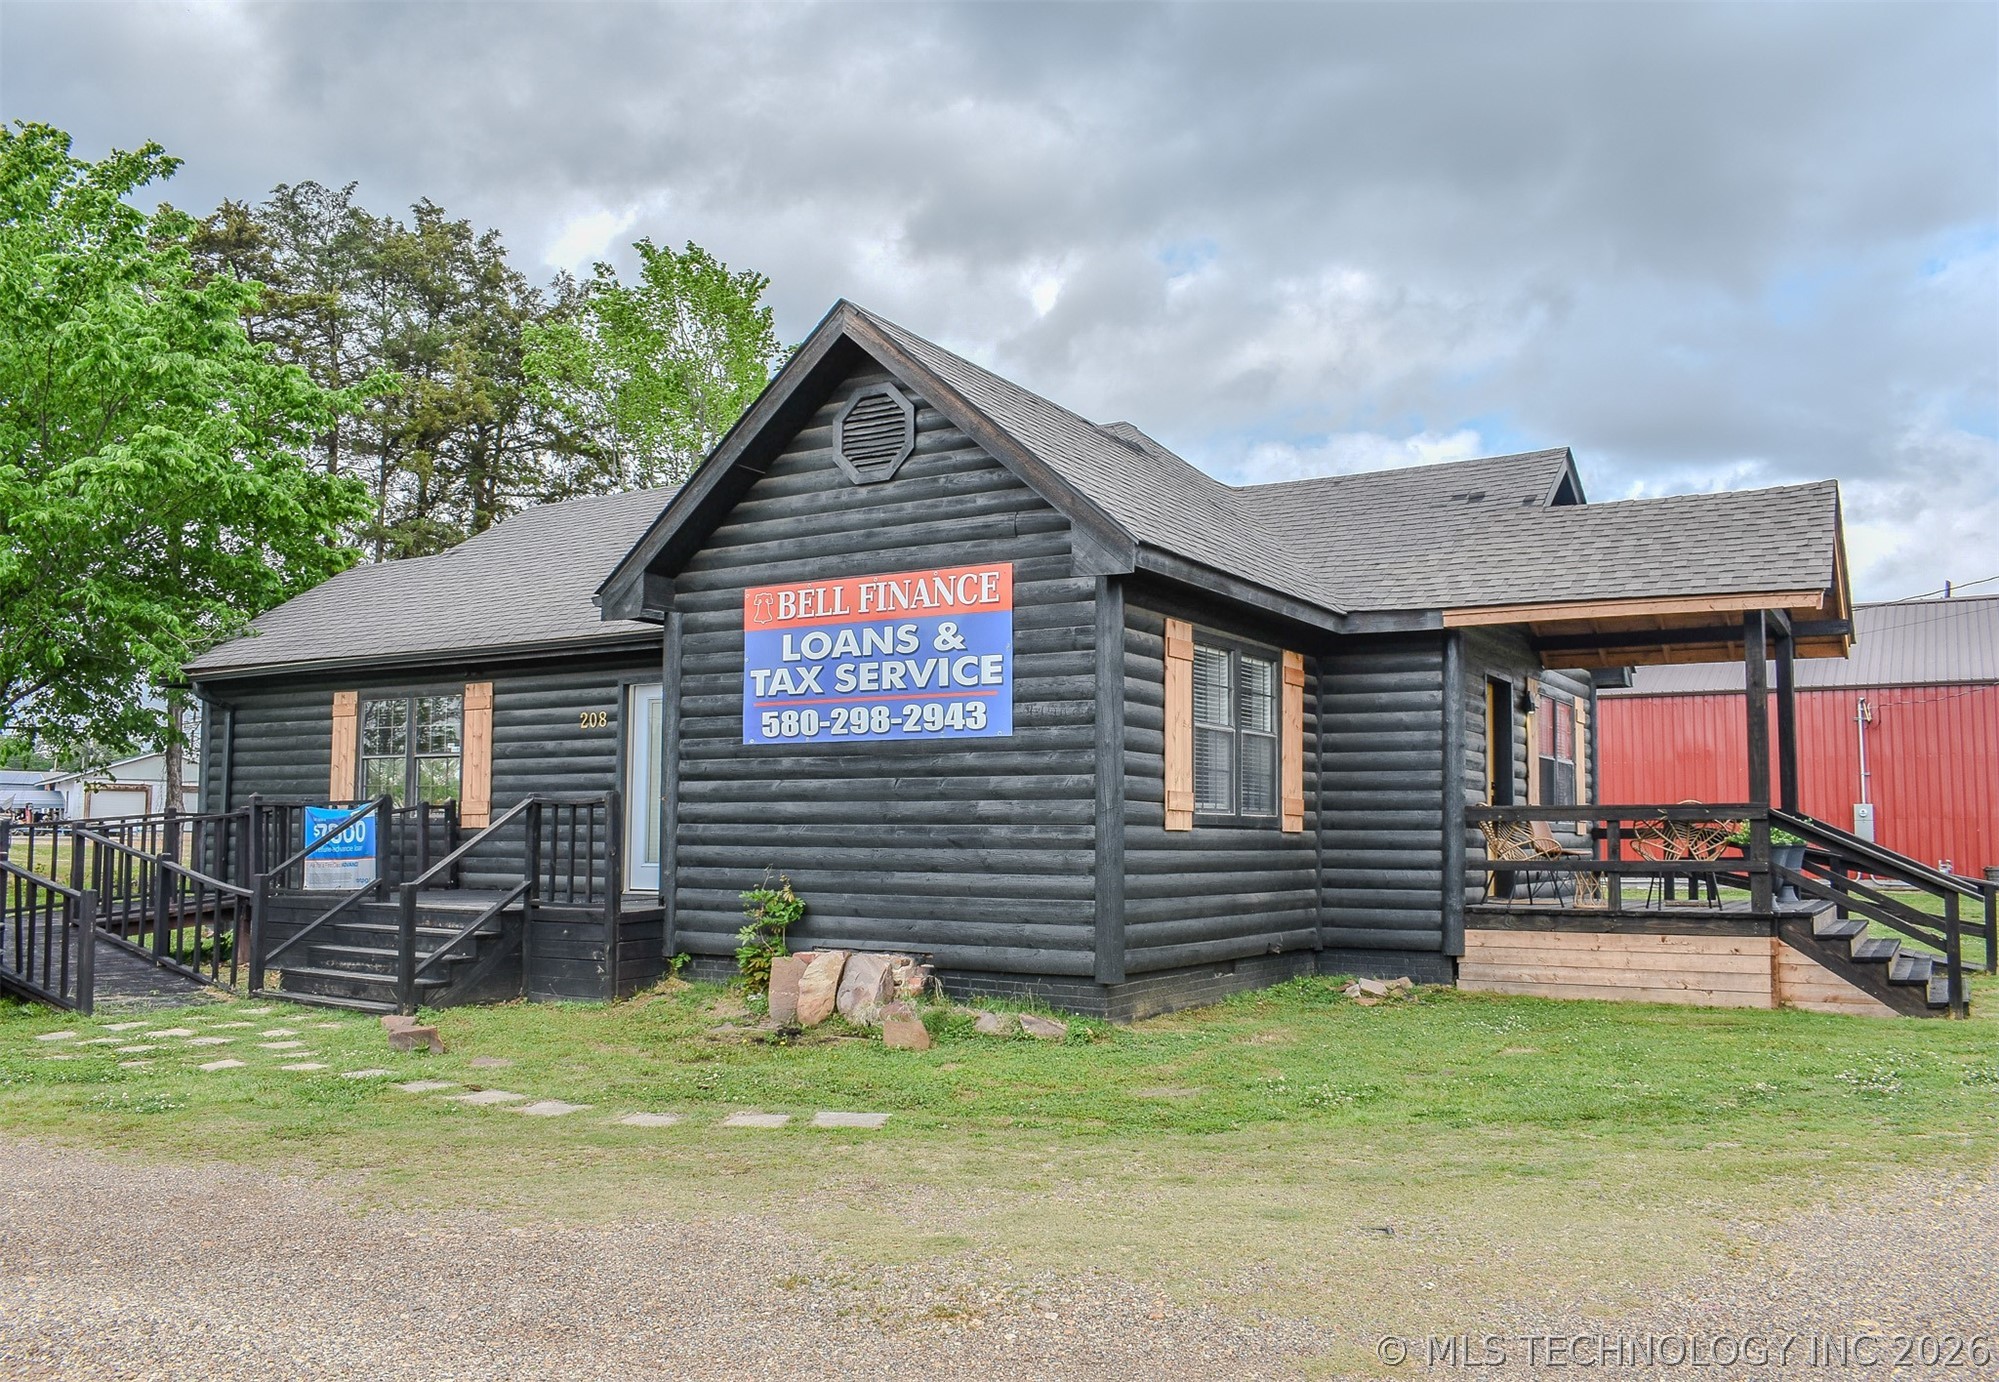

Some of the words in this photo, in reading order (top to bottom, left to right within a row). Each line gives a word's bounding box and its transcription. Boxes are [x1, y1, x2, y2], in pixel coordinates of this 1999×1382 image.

[777, 585, 850, 620] BELL
[857, 571, 1000, 613] FINANCE
[782, 624, 919, 662] LOANS
[933, 621, 966, 652] &
[750, 664, 825, 697] TAX
[834, 654, 1004, 693] SERVICE
[580, 711, 607, 729] 208
[761, 701, 988, 738] 580-298-2943
